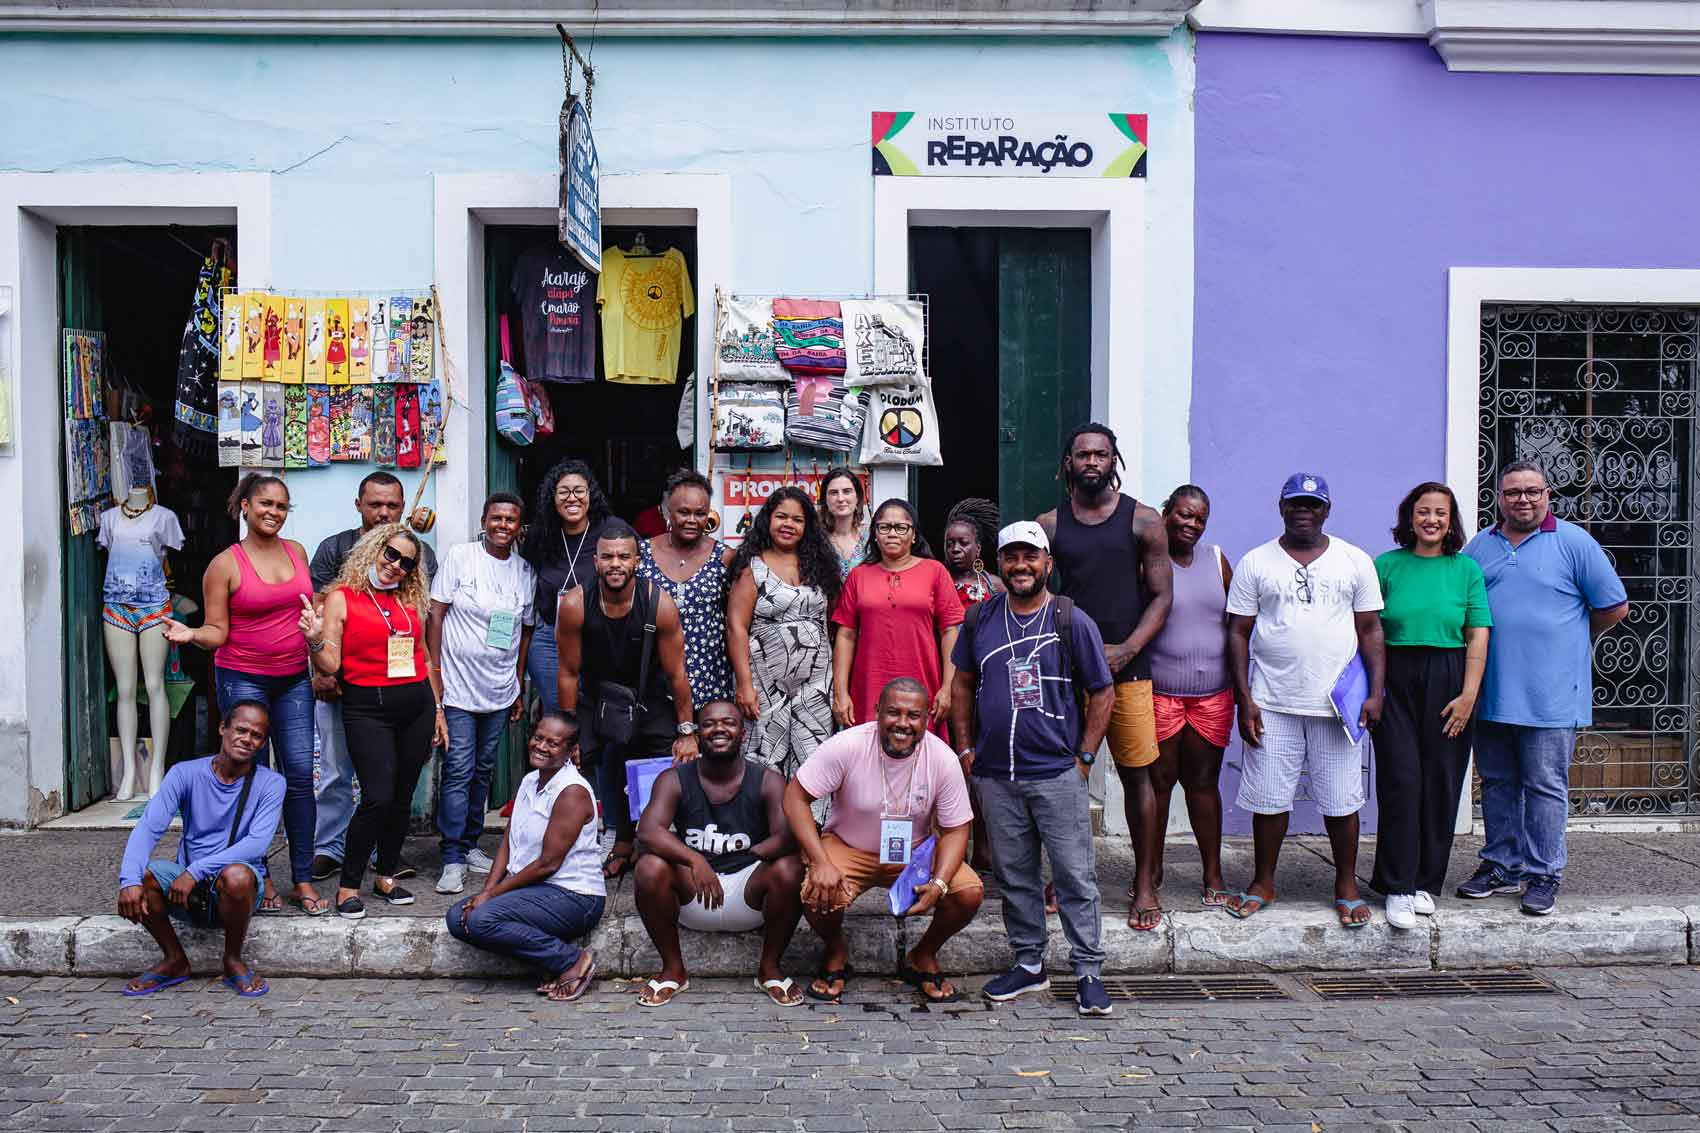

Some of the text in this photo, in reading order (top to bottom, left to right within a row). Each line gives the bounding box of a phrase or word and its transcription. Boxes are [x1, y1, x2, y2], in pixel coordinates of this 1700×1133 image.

[928, 117, 1014, 131] INSTITUTO
[928, 134, 1093, 173] REPARAÇÃO
[541, 267, 589, 294] Acarajé
[685, 823, 751, 855] afro
